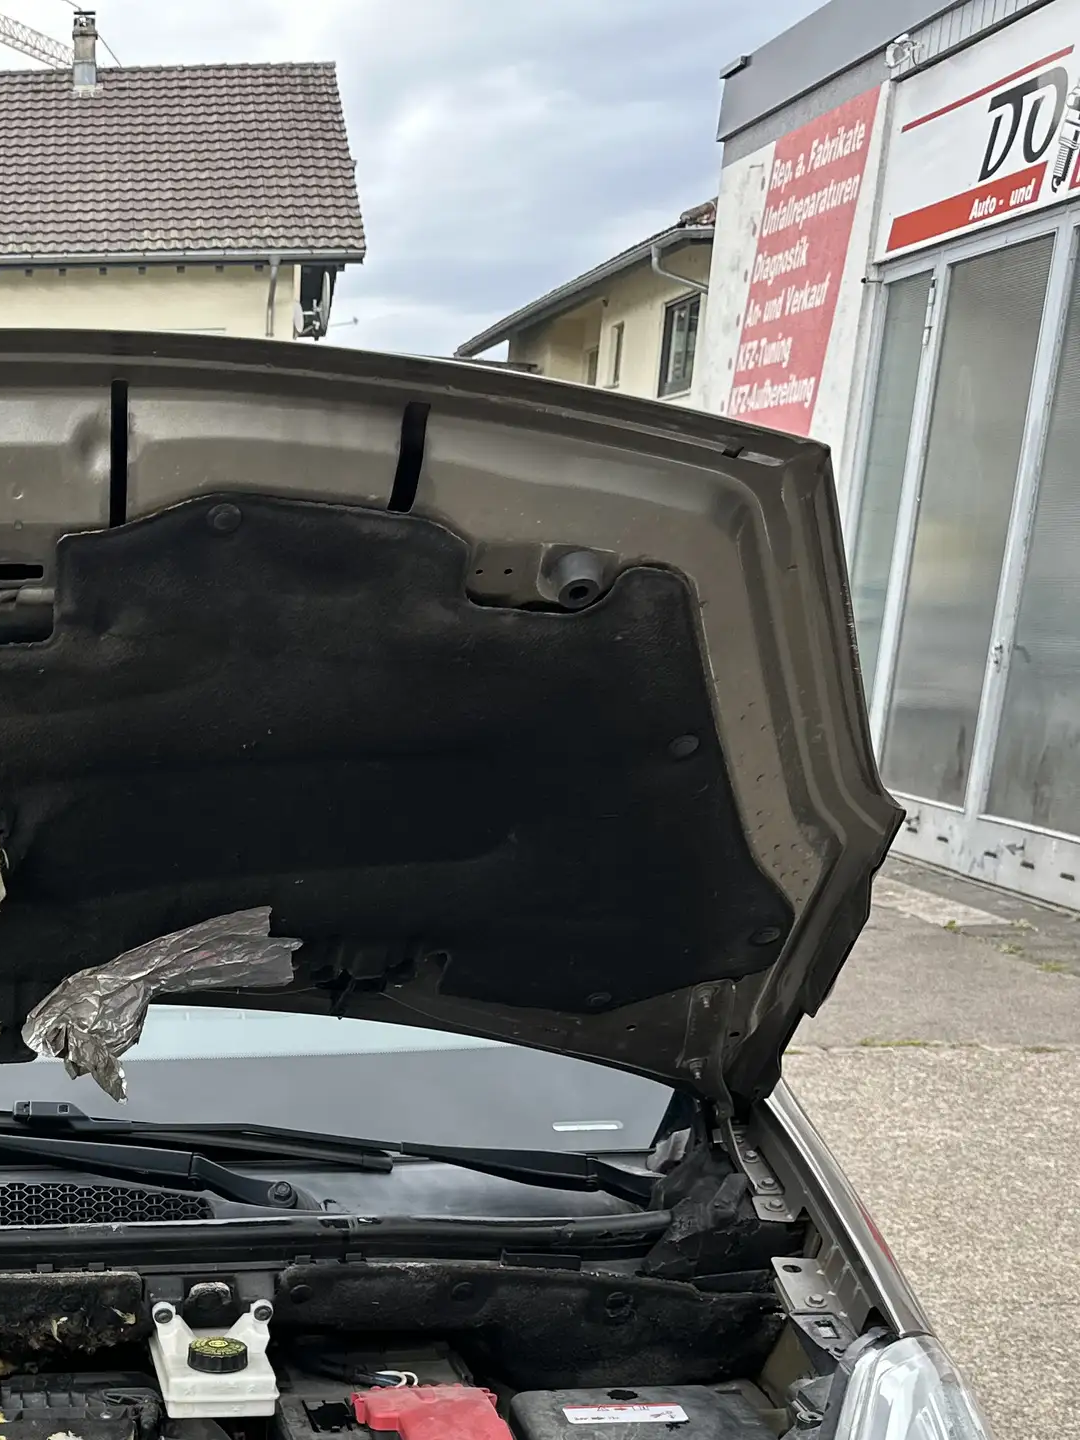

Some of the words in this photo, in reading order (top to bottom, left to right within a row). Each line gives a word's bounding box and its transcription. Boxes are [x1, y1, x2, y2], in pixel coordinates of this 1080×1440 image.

[770, 158, 793, 193] Rep.
[807, 119, 866, 173] Fabrikate
[762, 174, 861, 238] Unfallreparaturen
[1009, 178, 1036, 207] und
[752, 235, 809, 287] Diagnostik
[763, 285, 784, 322] und
[785, 271, 832, 316] Verkauf
[736, 332, 793, 373] KFZ-Tuning
[727, 374, 816, 416] KFZ-Aufbereitung
